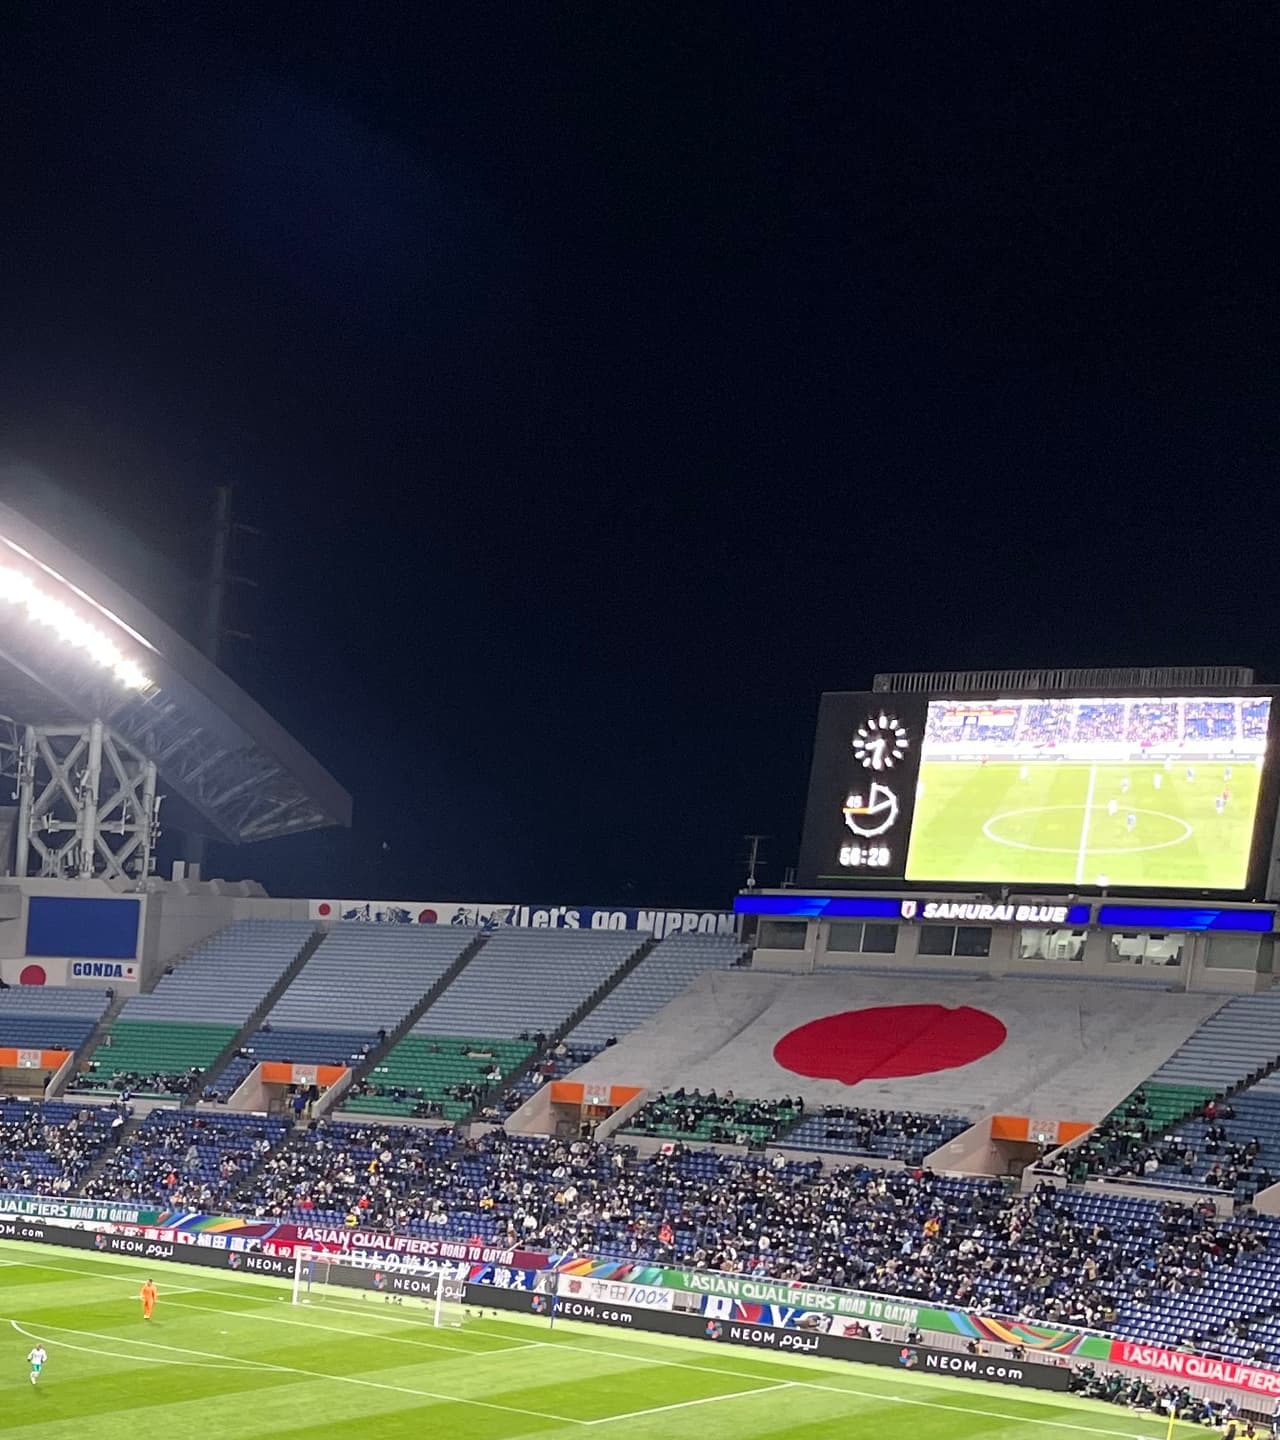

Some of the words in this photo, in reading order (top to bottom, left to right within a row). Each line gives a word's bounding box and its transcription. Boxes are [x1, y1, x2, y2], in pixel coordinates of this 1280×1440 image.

[520, 906, 581, 929] Let's
[637, 910, 735, 939] NIPPON
[922, 903, 1014, 921] SAMURAI
[1015, 905, 1068, 923] BLUE
[73, 962, 122, 977] GONDA
[70, 1206, 94, 1220] ROAD
[109, 1209, 138, 1223] QATAR
[112, 1239, 143, 1252] NEOM
[304, 1228, 350, 1248] ASIAN
[352, 1232, 438, 1255] QUALIFIERS
[440, 1243, 467, 1258] ROAD
[469, 1246, 480, 1260] TO
[482, 1248, 514, 1265] QATAR
[246, 1257, 310, 1275] NEOM.cm
[393, 1279, 431, 1294] NEOM
[690, 1276, 739, 1296] ASIAN
[741, 1282, 836, 1310] QUALIFIERS
[838, 1298, 866, 1315] ROAD
[869, 1302, 882, 1316] TO
[884, 1304, 918, 1324] QATAR
[554, 1302, 633, 1323] NEOM.com
[730, 1327, 775, 1344] NEOM
[926, 1354, 1024, 1380] NEOM.com
[1129, 1344, 1185, 1373] ASIAN
